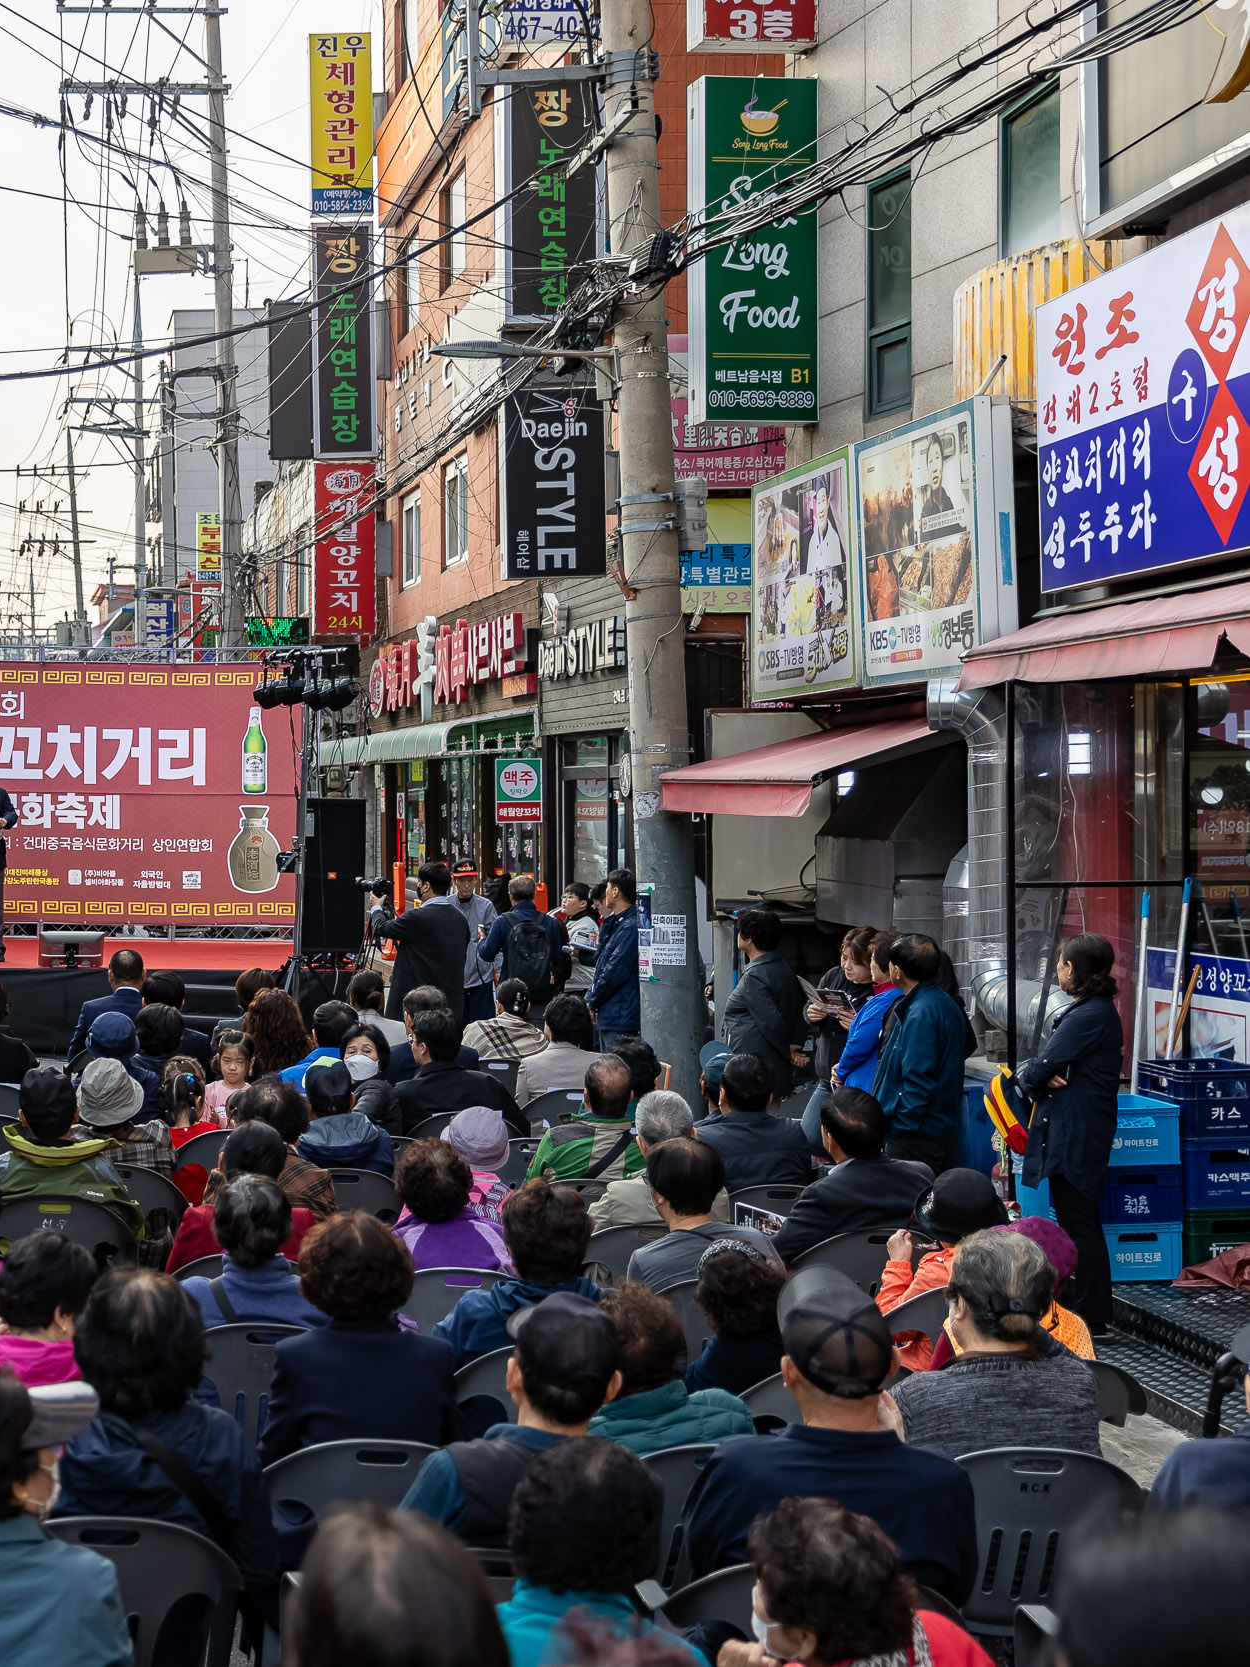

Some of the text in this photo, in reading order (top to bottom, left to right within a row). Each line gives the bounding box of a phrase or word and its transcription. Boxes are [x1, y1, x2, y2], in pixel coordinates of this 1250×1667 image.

[729, 10, 794, 39] 3층
[316, 36, 367, 60] 진우
[323, 61, 359, 170] 체형관리
[534, 89, 572, 127] 짱
[732, 137, 789, 152] Song Long Food
[331, 174, 354, 187] 2F
[534, 139, 568, 308] 노래연습장
[325, 237, 361, 274] 짱
[721, 235, 791, 281] Long
[718, 289, 801, 333] Food
[1052, 290, 1140, 376] 원조
[328, 285, 361, 444] 노래연습장
[715, 368, 811, 385] 베트남음식점 B1
[708, 391, 815, 409] 010-5696-9889
[521, 418, 588, 441] Daejin
[534, 447, 577, 571] STYLE
[1043, 489, 1157, 570] 선두주자
[328, 615, 363, 630] 24시
[538, 618, 616, 681] Daejin STYLE
[870, 630, 888, 652] KBS
[503, 770, 534, 786] 맥주
[498, 807, 540, 817] 해월양꼬치
[22, 837, 213, 852] 건대중국음식문화거리 상인연합회
[140, 870, 164, 880] 외국인
[652, 915, 686, 925] 신축아파트
[1193, 966, 1250, 994] 성양꼬
[1211, 1107, 1241, 1121] 카스
[1124, 1138, 1159, 1147] 하이트진로
[1115, 1253, 1162, 1263] 하이트진로
